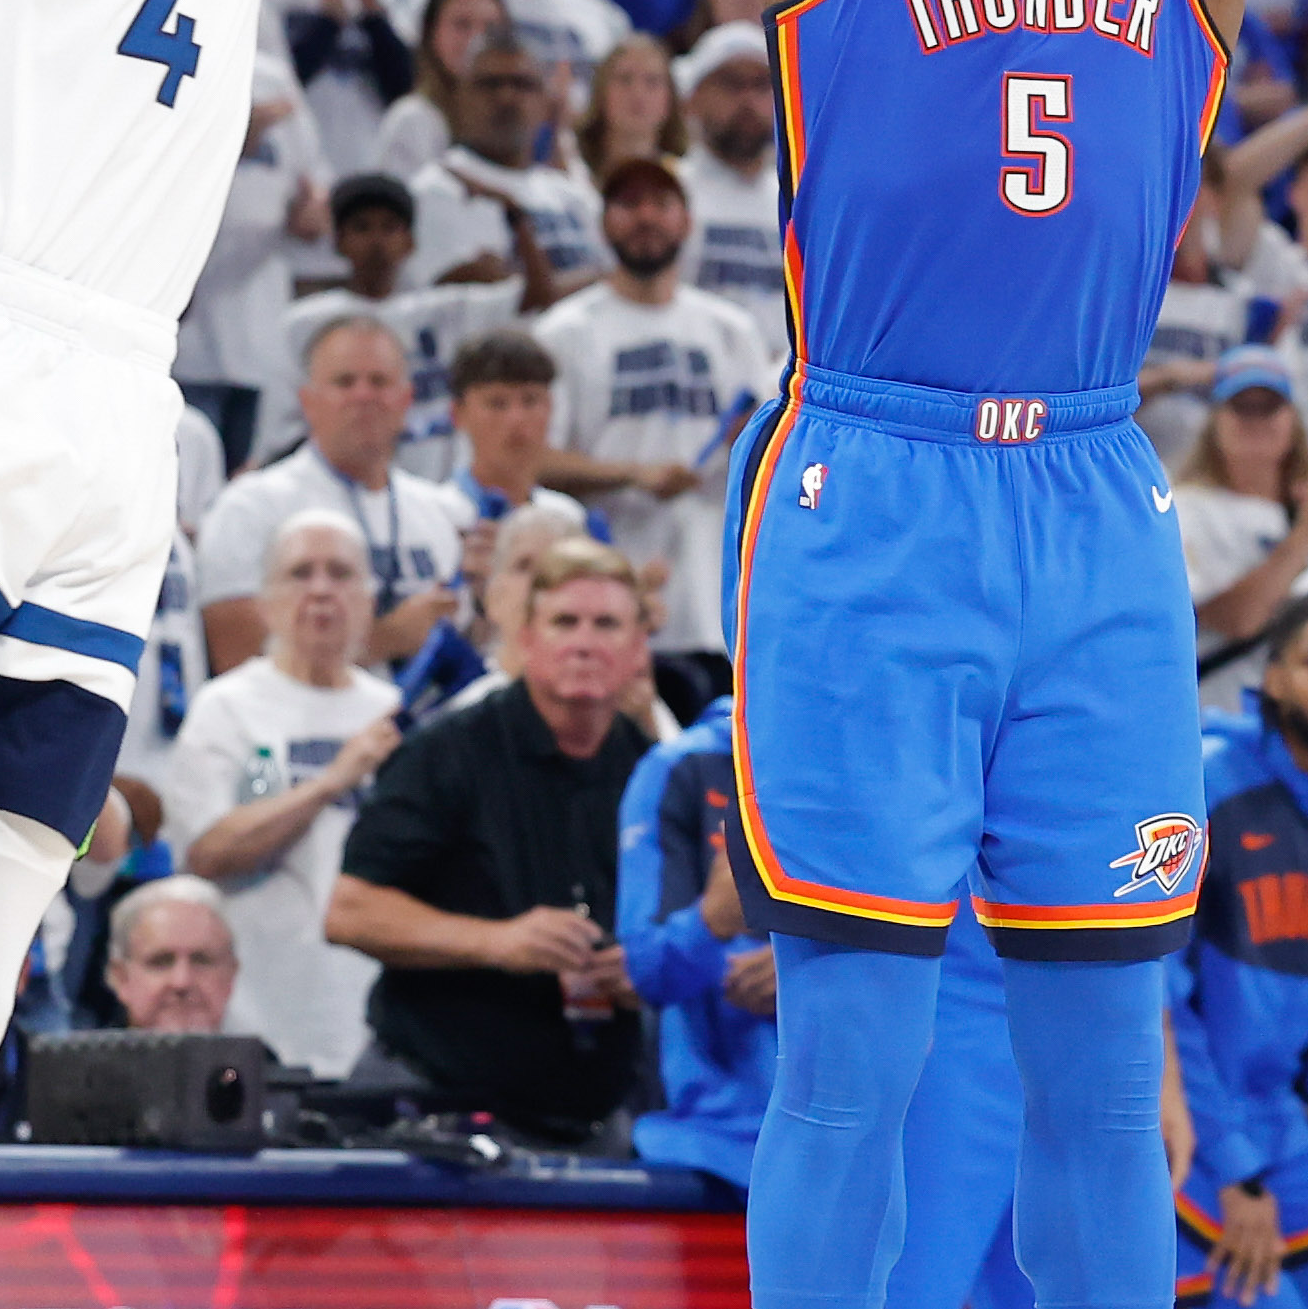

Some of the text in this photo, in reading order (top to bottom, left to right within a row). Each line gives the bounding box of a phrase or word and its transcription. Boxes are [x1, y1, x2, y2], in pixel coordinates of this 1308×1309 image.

[999, 71, 1073, 217] 5
[976, 398, 1048, 444] OKC
[1137, 830, 1189, 876] OKC
